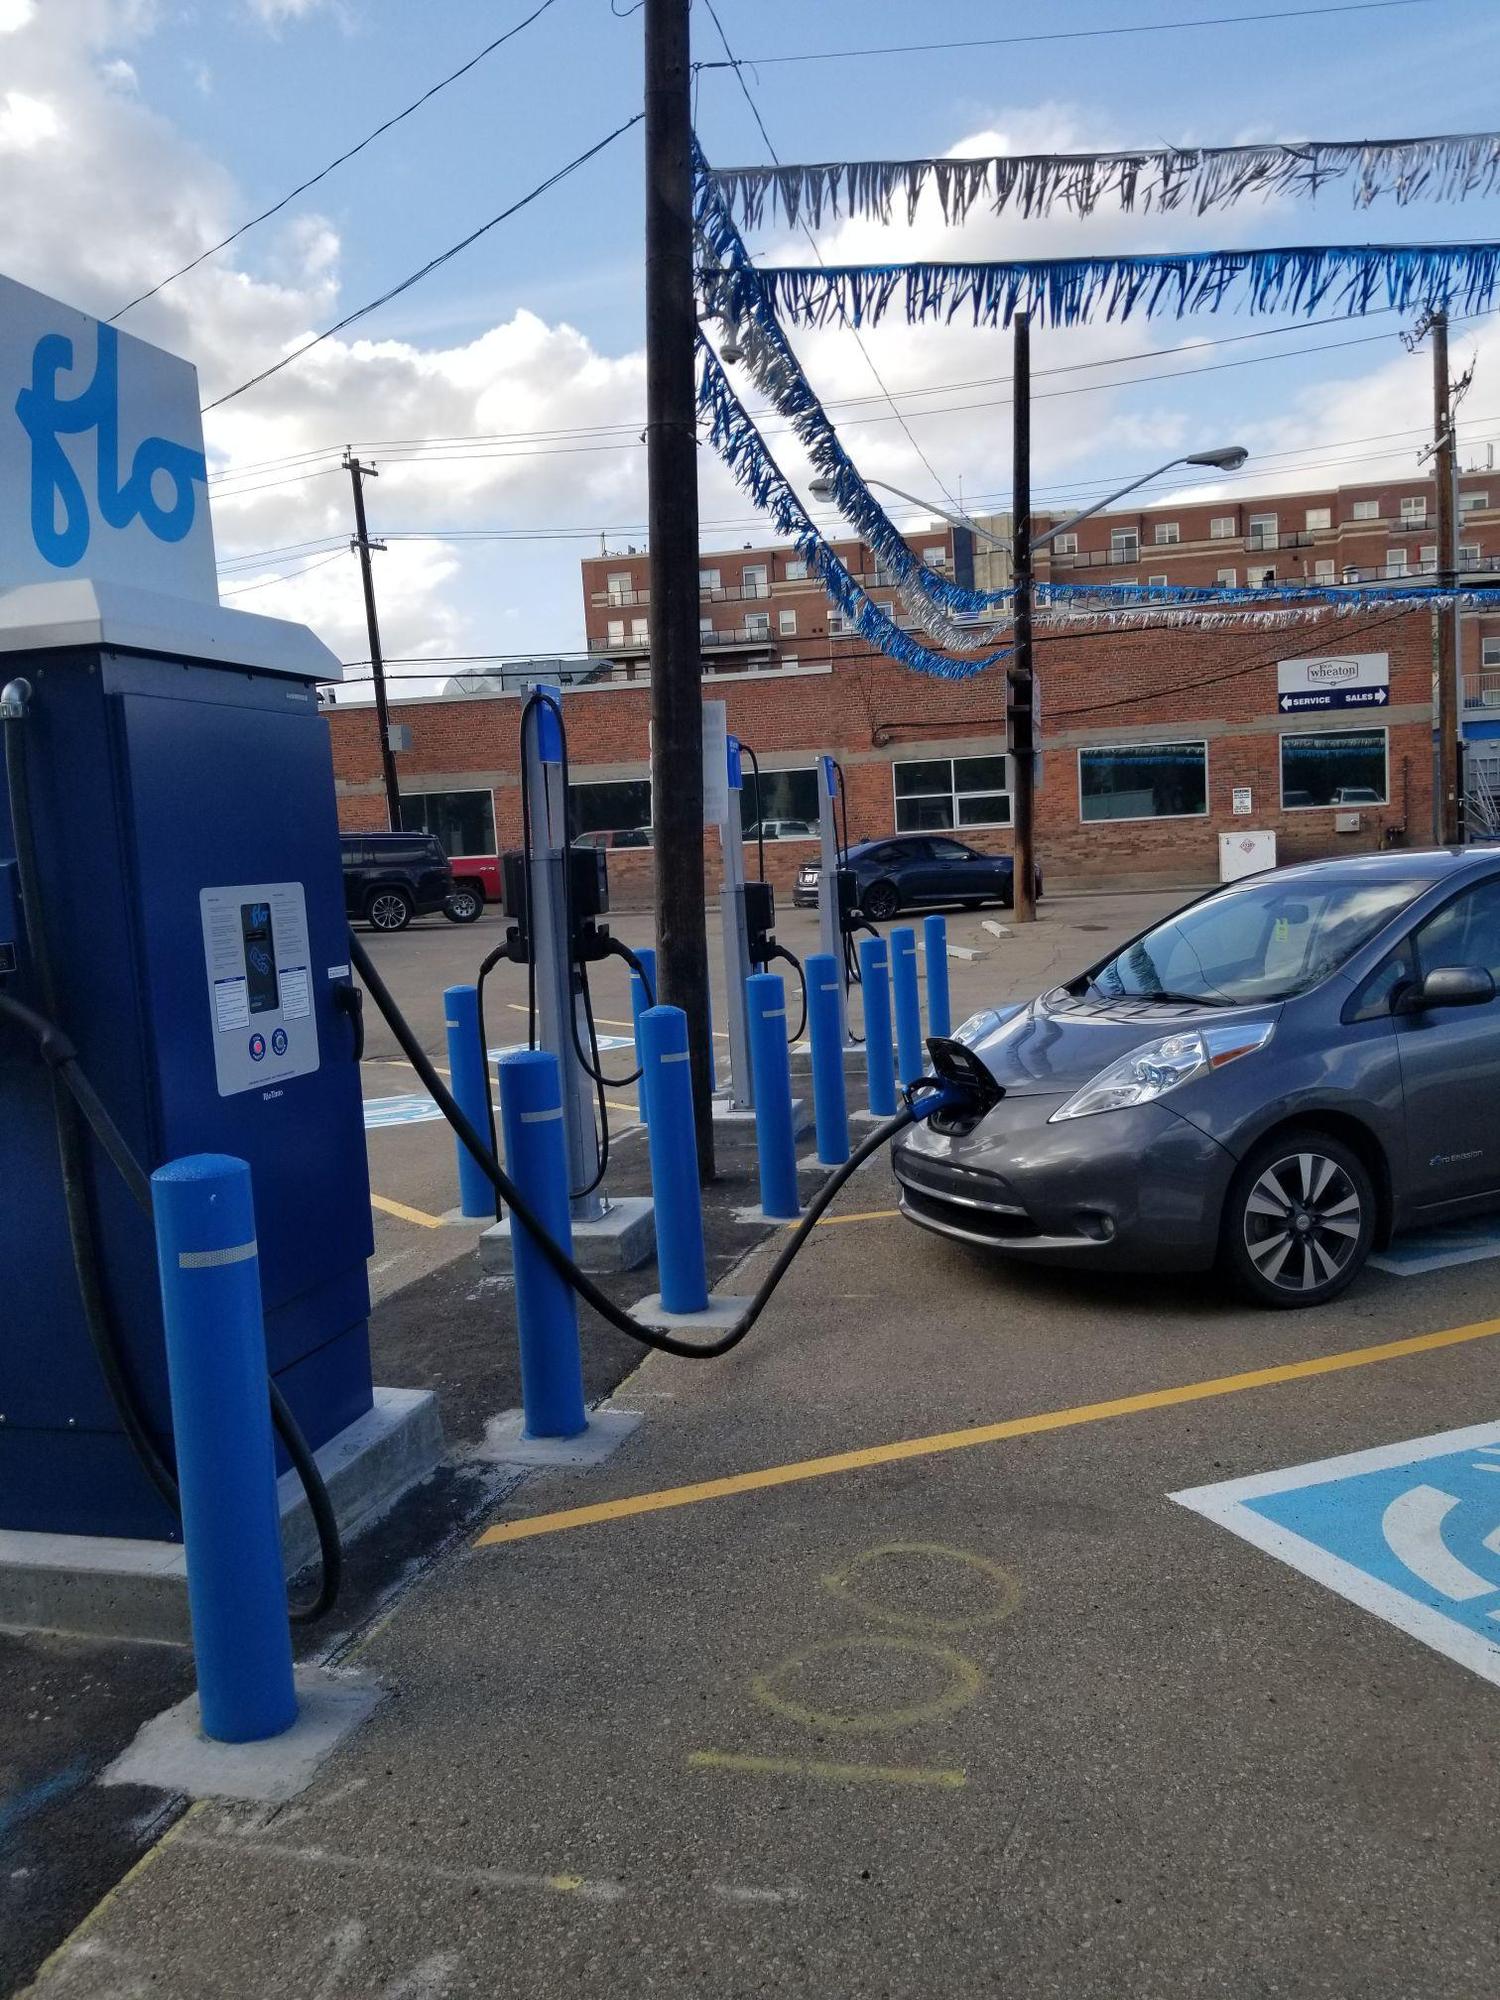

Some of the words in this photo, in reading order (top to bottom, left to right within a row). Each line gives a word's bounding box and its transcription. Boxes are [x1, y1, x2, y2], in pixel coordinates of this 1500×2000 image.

[15, 320, 207, 567] flo
[1310, 664, 1355, 676] wheaton
[1293, 697, 1330, 705] SERVICE
[1345, 693, 1373, 701] SALES
